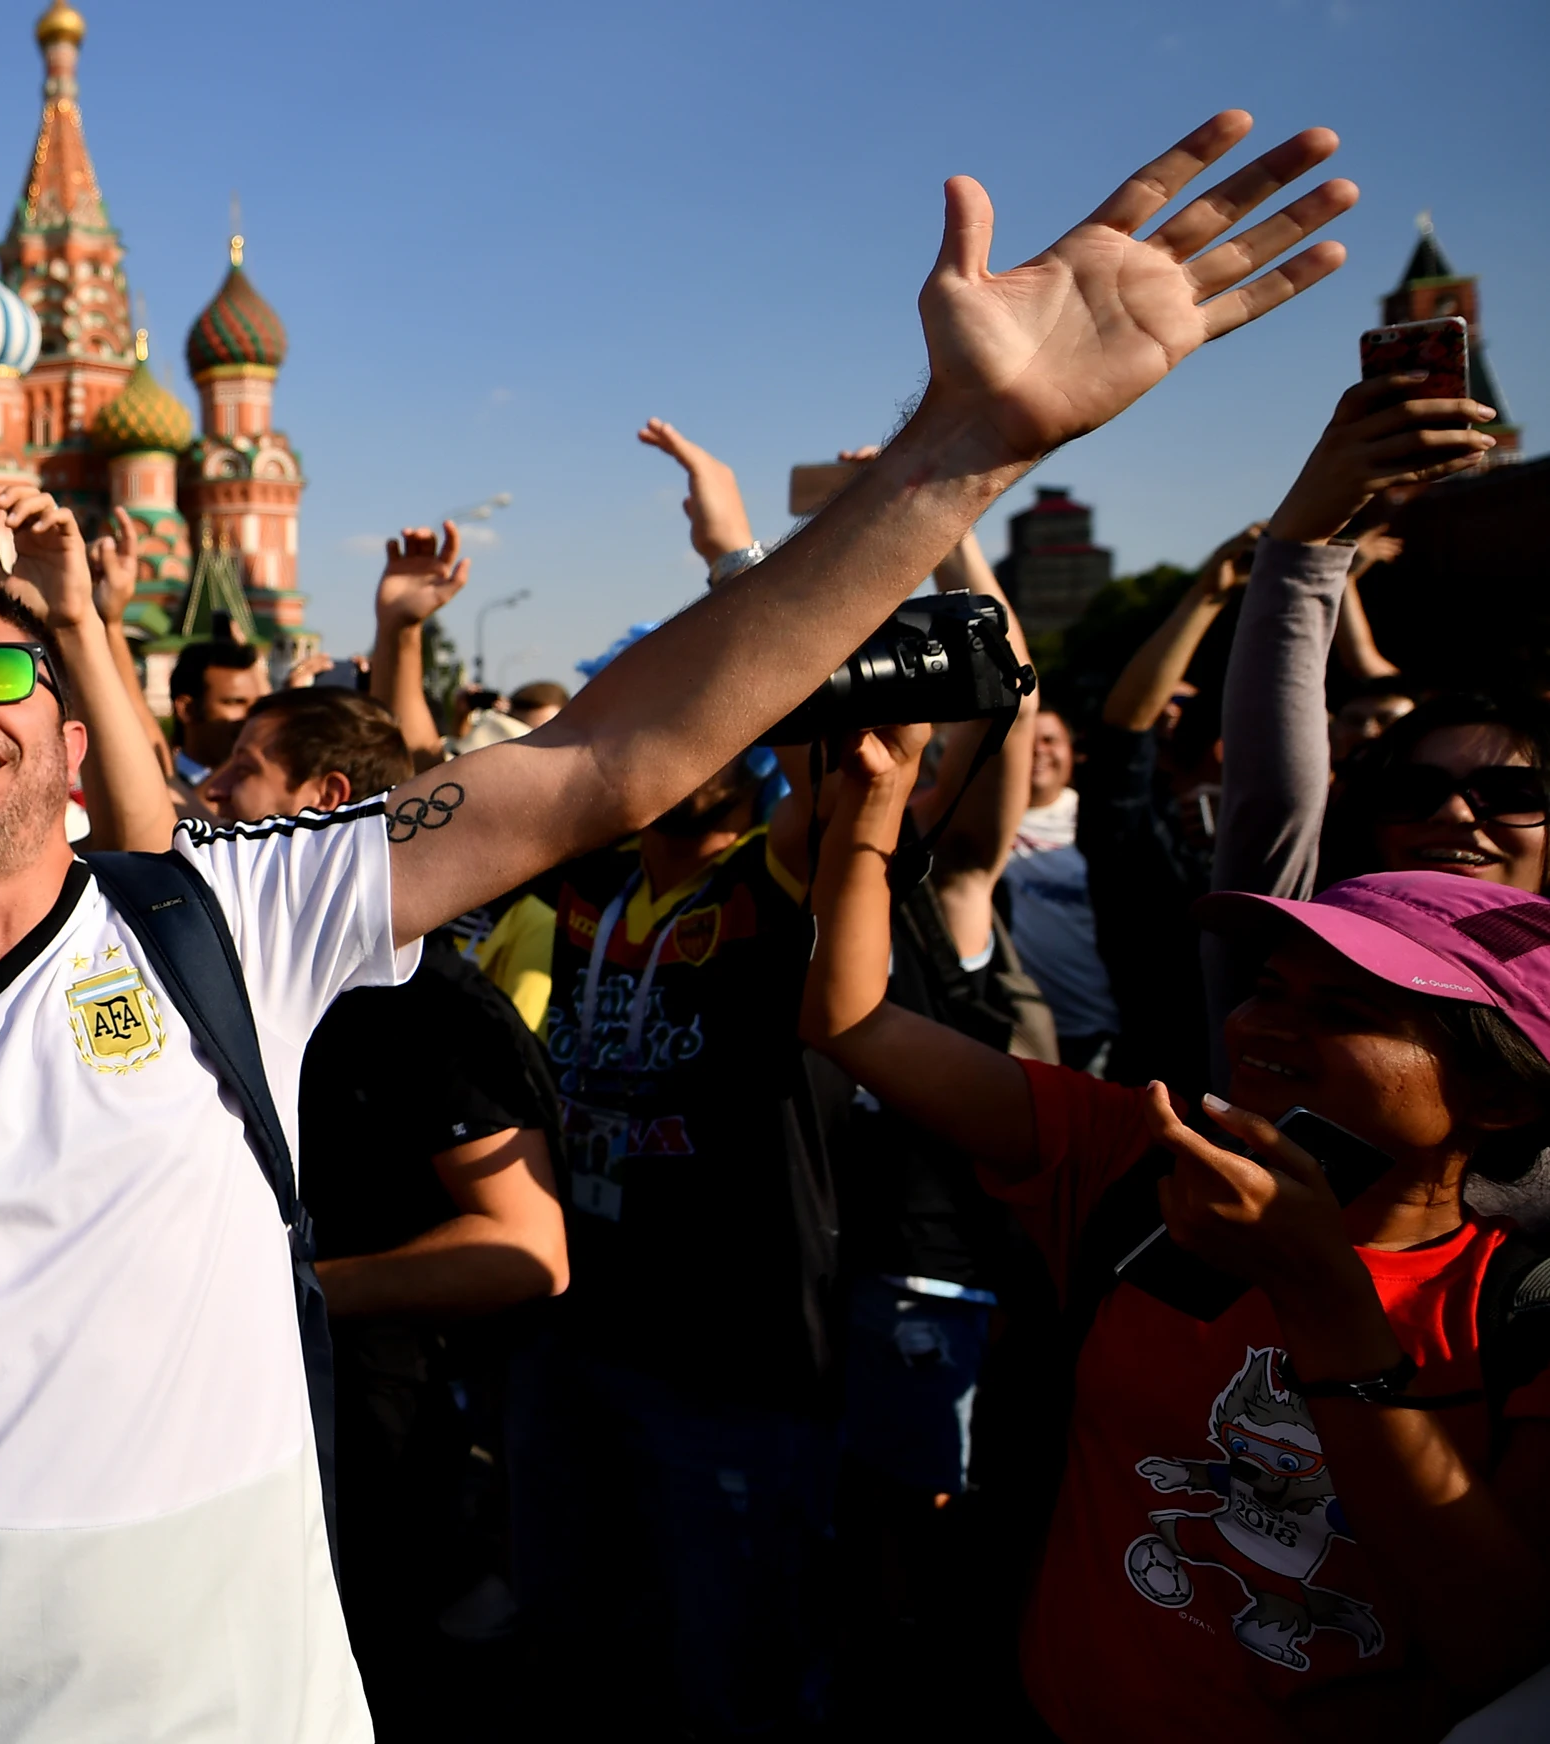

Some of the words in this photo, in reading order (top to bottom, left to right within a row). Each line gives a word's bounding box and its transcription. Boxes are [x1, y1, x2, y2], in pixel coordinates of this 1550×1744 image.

[1428, 979, 1474, 993] Quechua
[94, 995, 141, 1040] AFA
[1235, 1499, 1298, 1548] 2018
[1236, 1488, 1302, 1534] RUSSIA
[1188, 1615, 1206, 1630] FIFA
